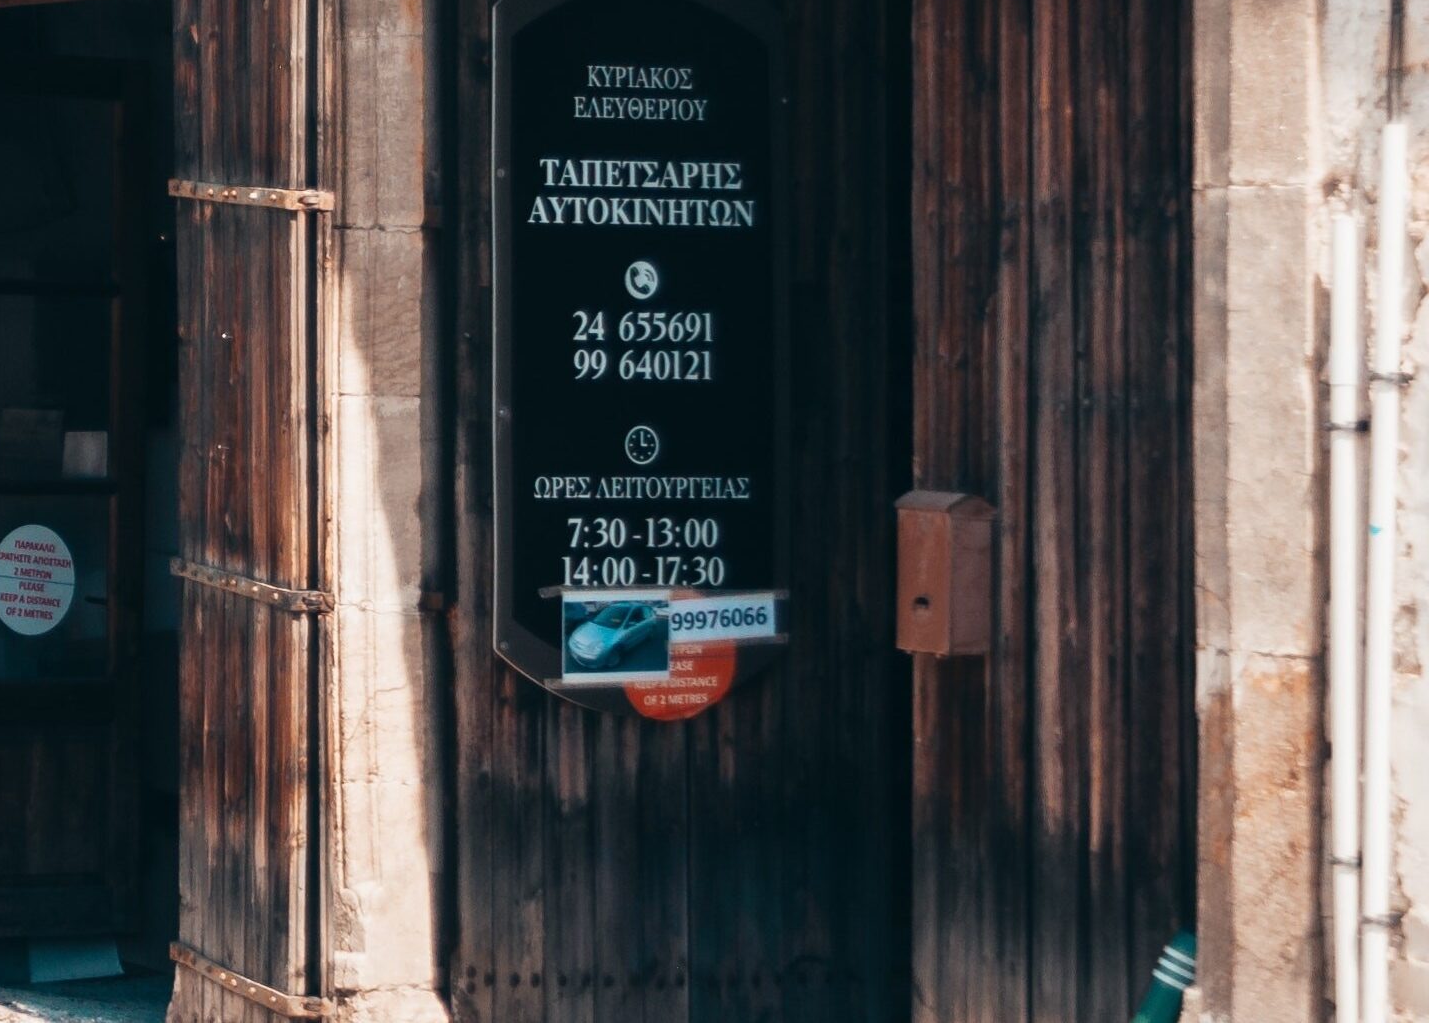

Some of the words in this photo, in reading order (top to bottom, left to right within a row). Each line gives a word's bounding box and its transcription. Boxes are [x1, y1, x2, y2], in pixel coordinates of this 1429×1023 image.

[587, 65, 693, 90] ΚΥΡΙΑΚΟΣ
[573, 96, 708, 121] ΕΛΕΥΘΕΡΙΟΥ
[540, 159, 743, 190] ΤΑΠΕΤΣΑΡΗΣ
[527, 196, 756, 227] ΑΥΤΟΚΙΝΗΤΩΝ
[572, 311, 605, 341] 24
[619, 311, 713, 342] 655691
[573, 349, 607, 380] 99
[619, 349, 712, 381] 640121
[533, 476, 591, 499] ΩΡΕΣ
[595, 476, 750, 500] ΛΕΙΤΟΥΡΓΕΙΑΣ
[567, 517, 626, 548] 7:30
[15, 540, 55, 553] ΠΑΡΑΚΑΛΩ
[562, 556, 636, 587] 14:00
[19, 581, 45, 592] PLEASE
[0, 592, 18, 602] KEEP
[19, 595, 25, 604] A
[27, 595, 61, 608] DISTANCE
[6, 607, 16, 616] OF
[24, 609, 54, 620] METRES
[672, 606, 767, 631] 99976066
[644, 695, 657, 706] OF
[668, 693, 709, 705] METRES
